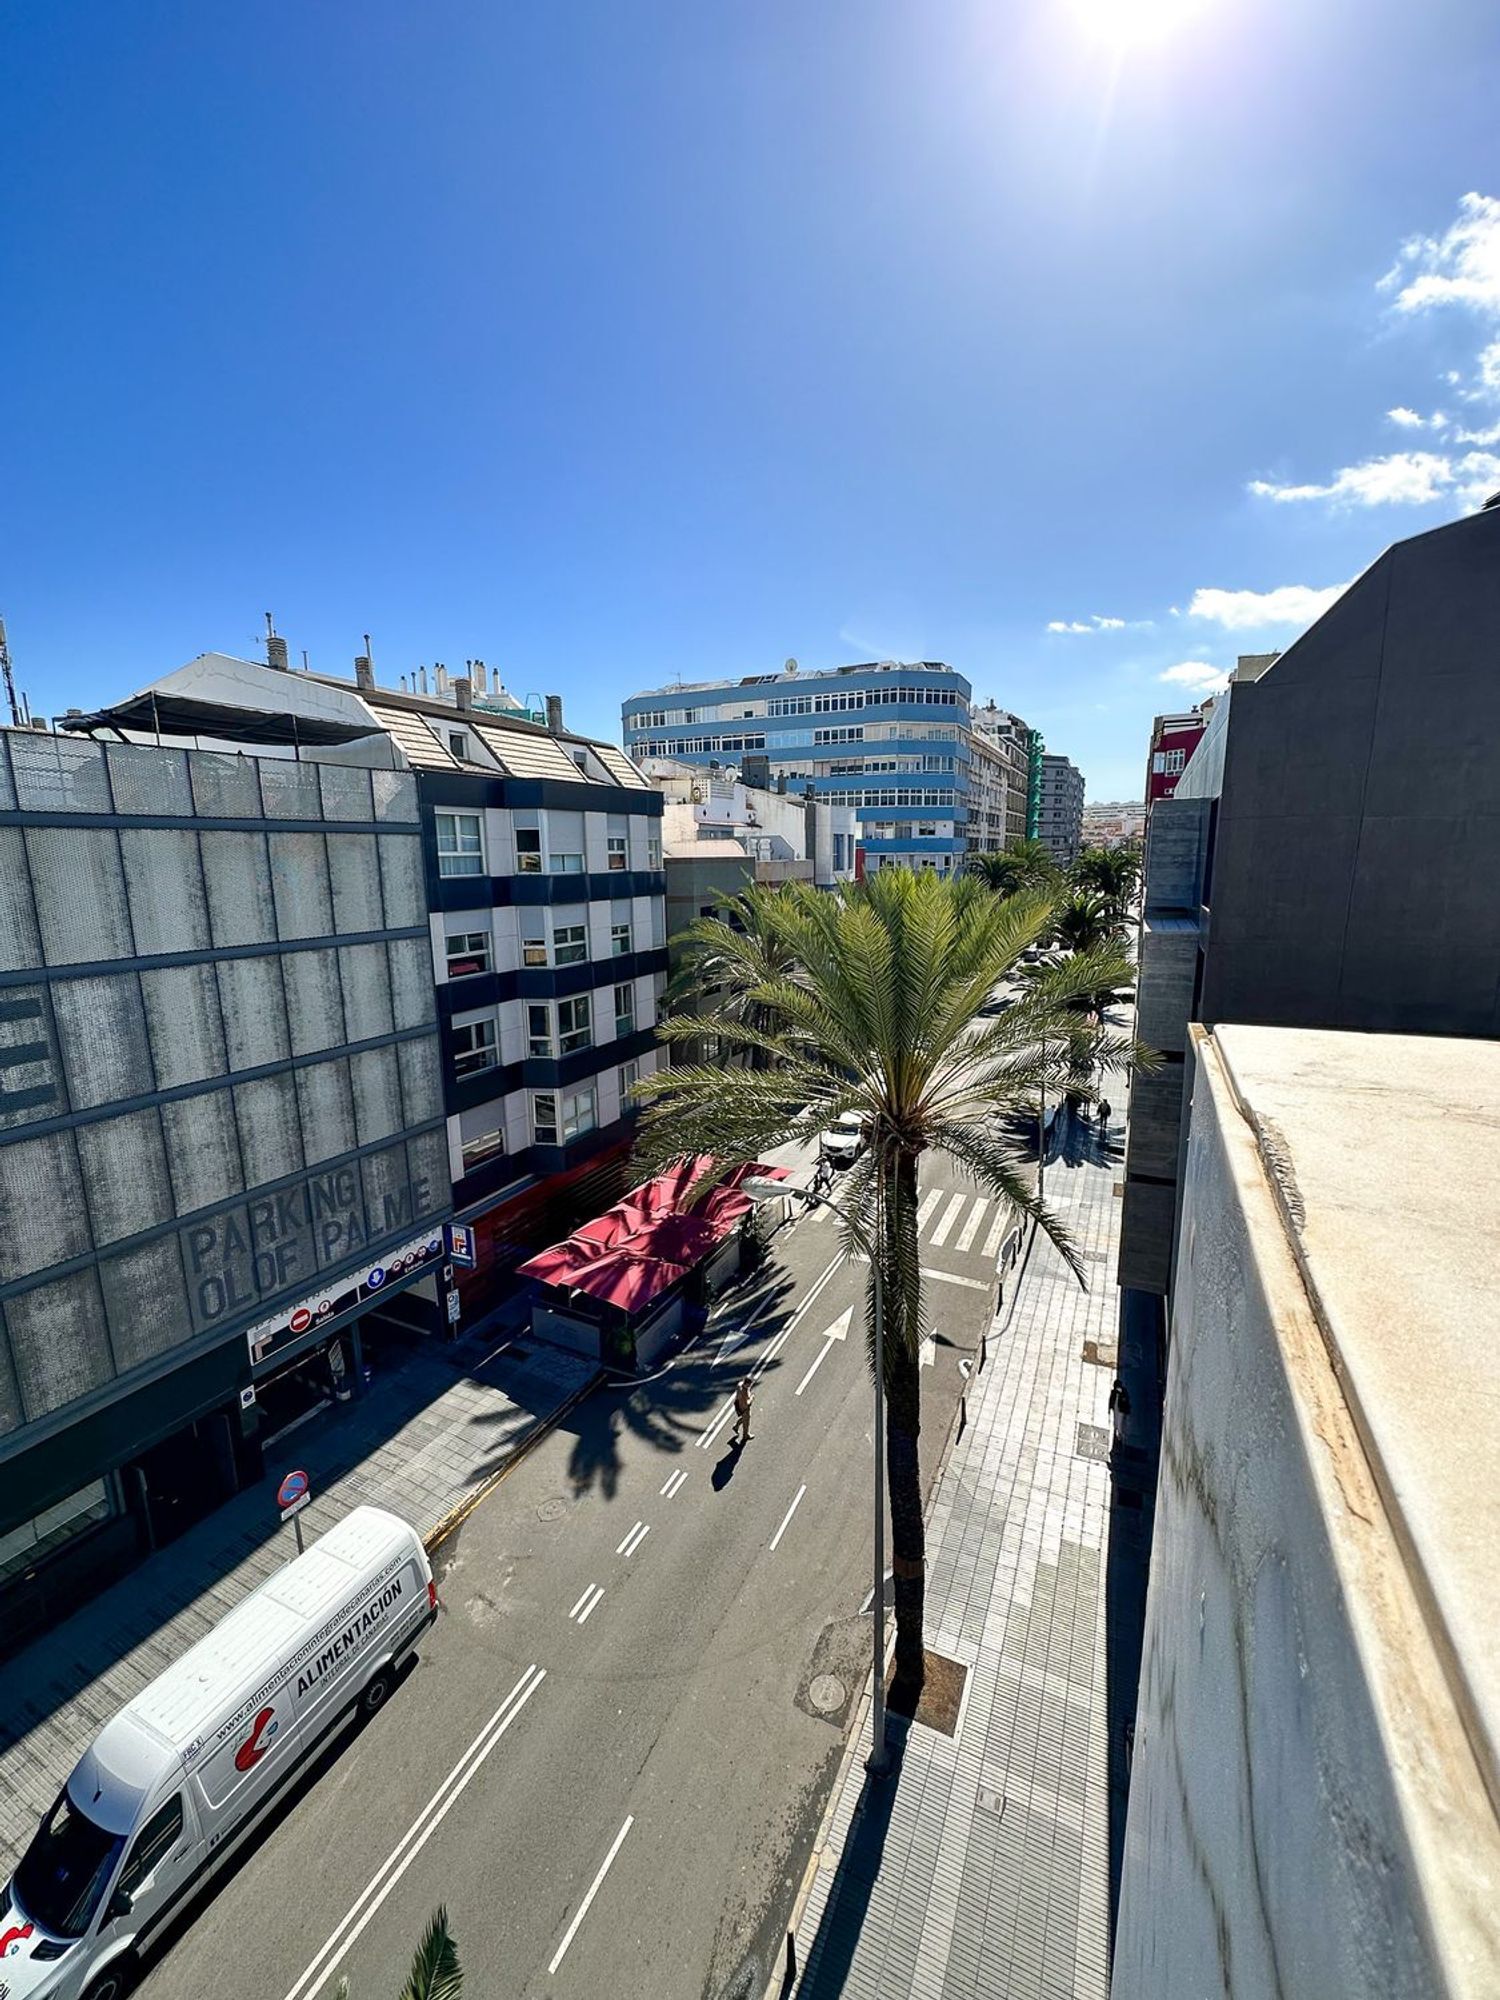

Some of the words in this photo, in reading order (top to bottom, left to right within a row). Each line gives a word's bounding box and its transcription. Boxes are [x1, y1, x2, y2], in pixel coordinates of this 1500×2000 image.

[188, 1170, 357, 1275] PARKING
[200, 1237, 298, 1320] OLOF
[321, 1177, 431, 1262] PALME
[216, 1556, 402, 1740] www.alimentacionintegraldecanarias.com
[298, 1579, 403, 1697] ALIMENTACIÓN
